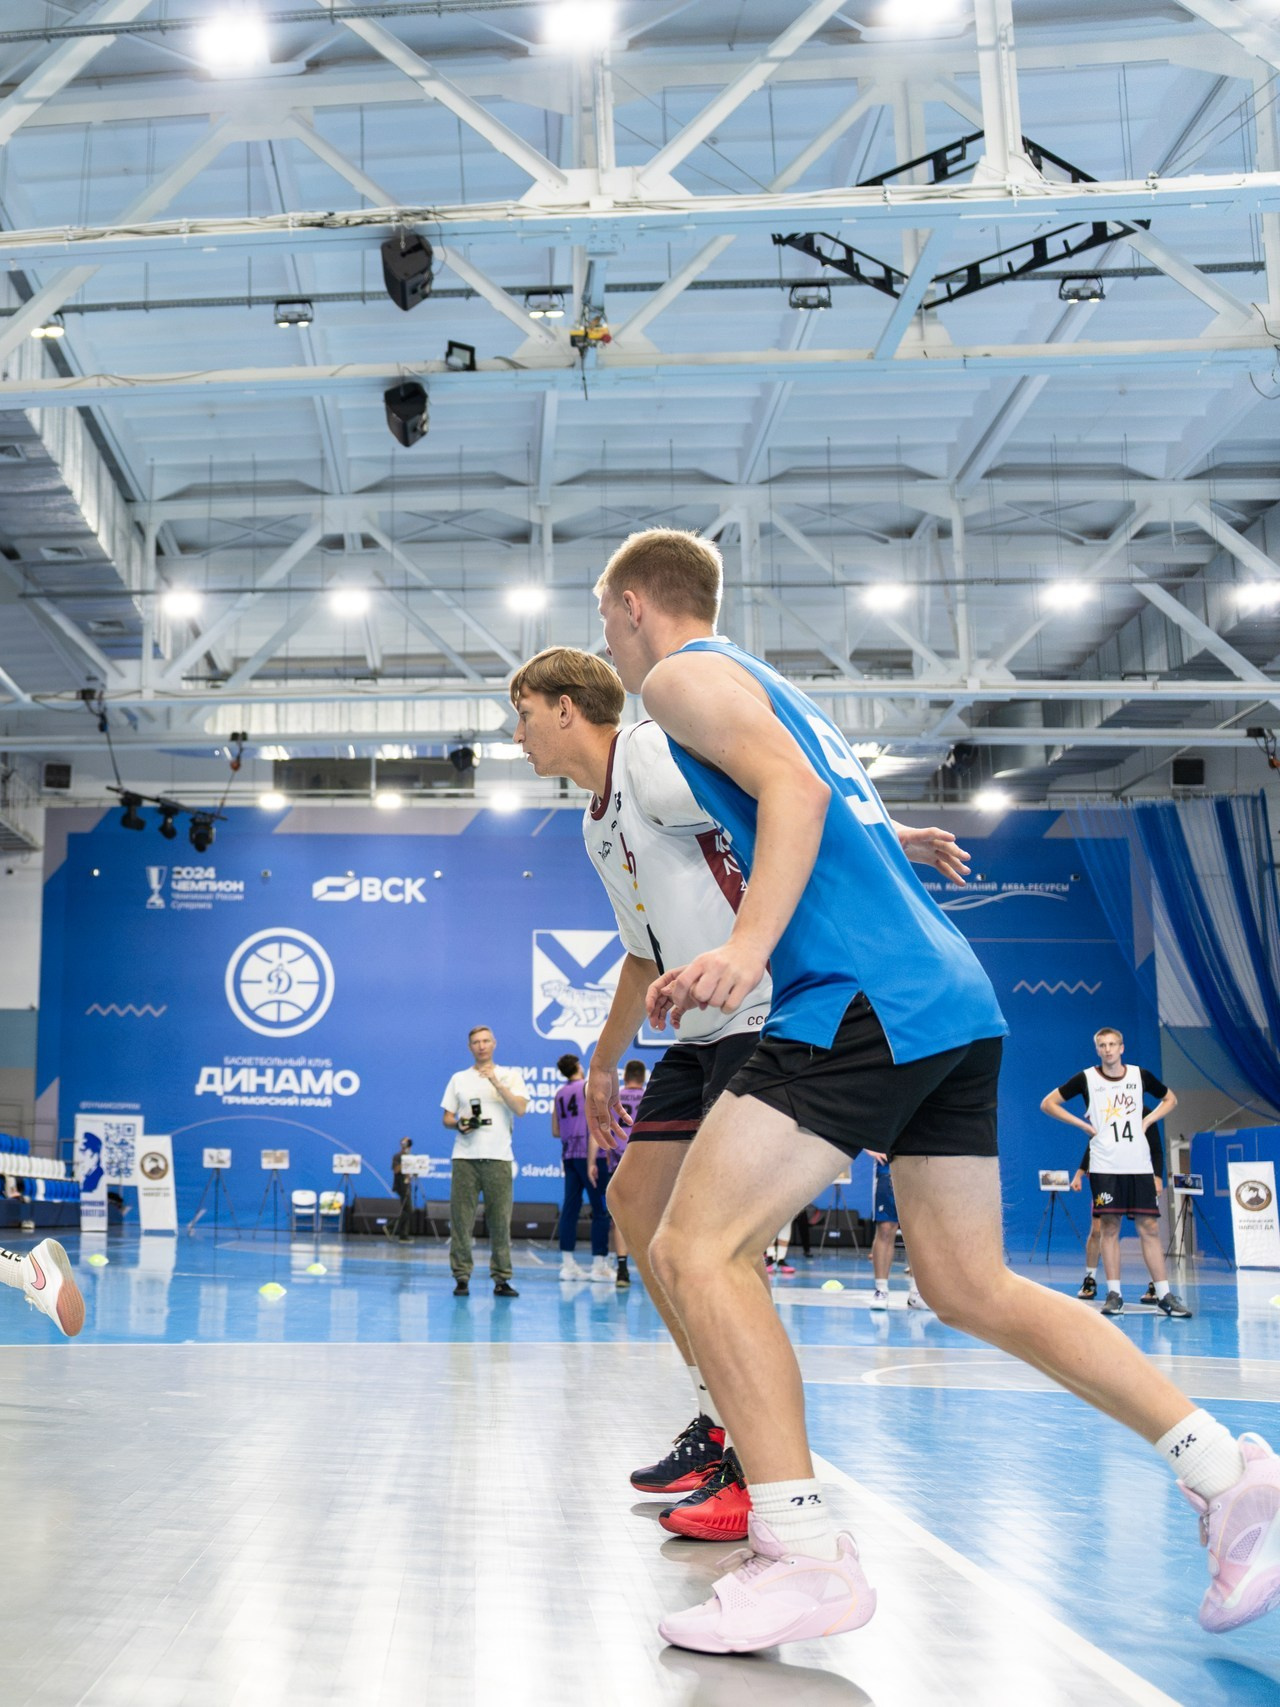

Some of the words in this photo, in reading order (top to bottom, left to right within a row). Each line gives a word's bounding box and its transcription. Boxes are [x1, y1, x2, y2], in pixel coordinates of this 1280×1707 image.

[171, 880, 245, 893] ЧЕМПИОН
[361, 877, 427, 904] ВСК
[223, 1056, 306, 1067] БАСКЕТБОЛЬНЫЙ
[308, 1058, 333, 1068] КЛУБ
[195, 1067, 361, 1097] ДИНАМО
[222, 1096, 299, 1106] ПРИМОРСКИЙ
[300, 1097, 333, 1107] КРАЙ
[559, 1093, 579, 1119] 14
[1110, 1121, 1134, 1143] 14
